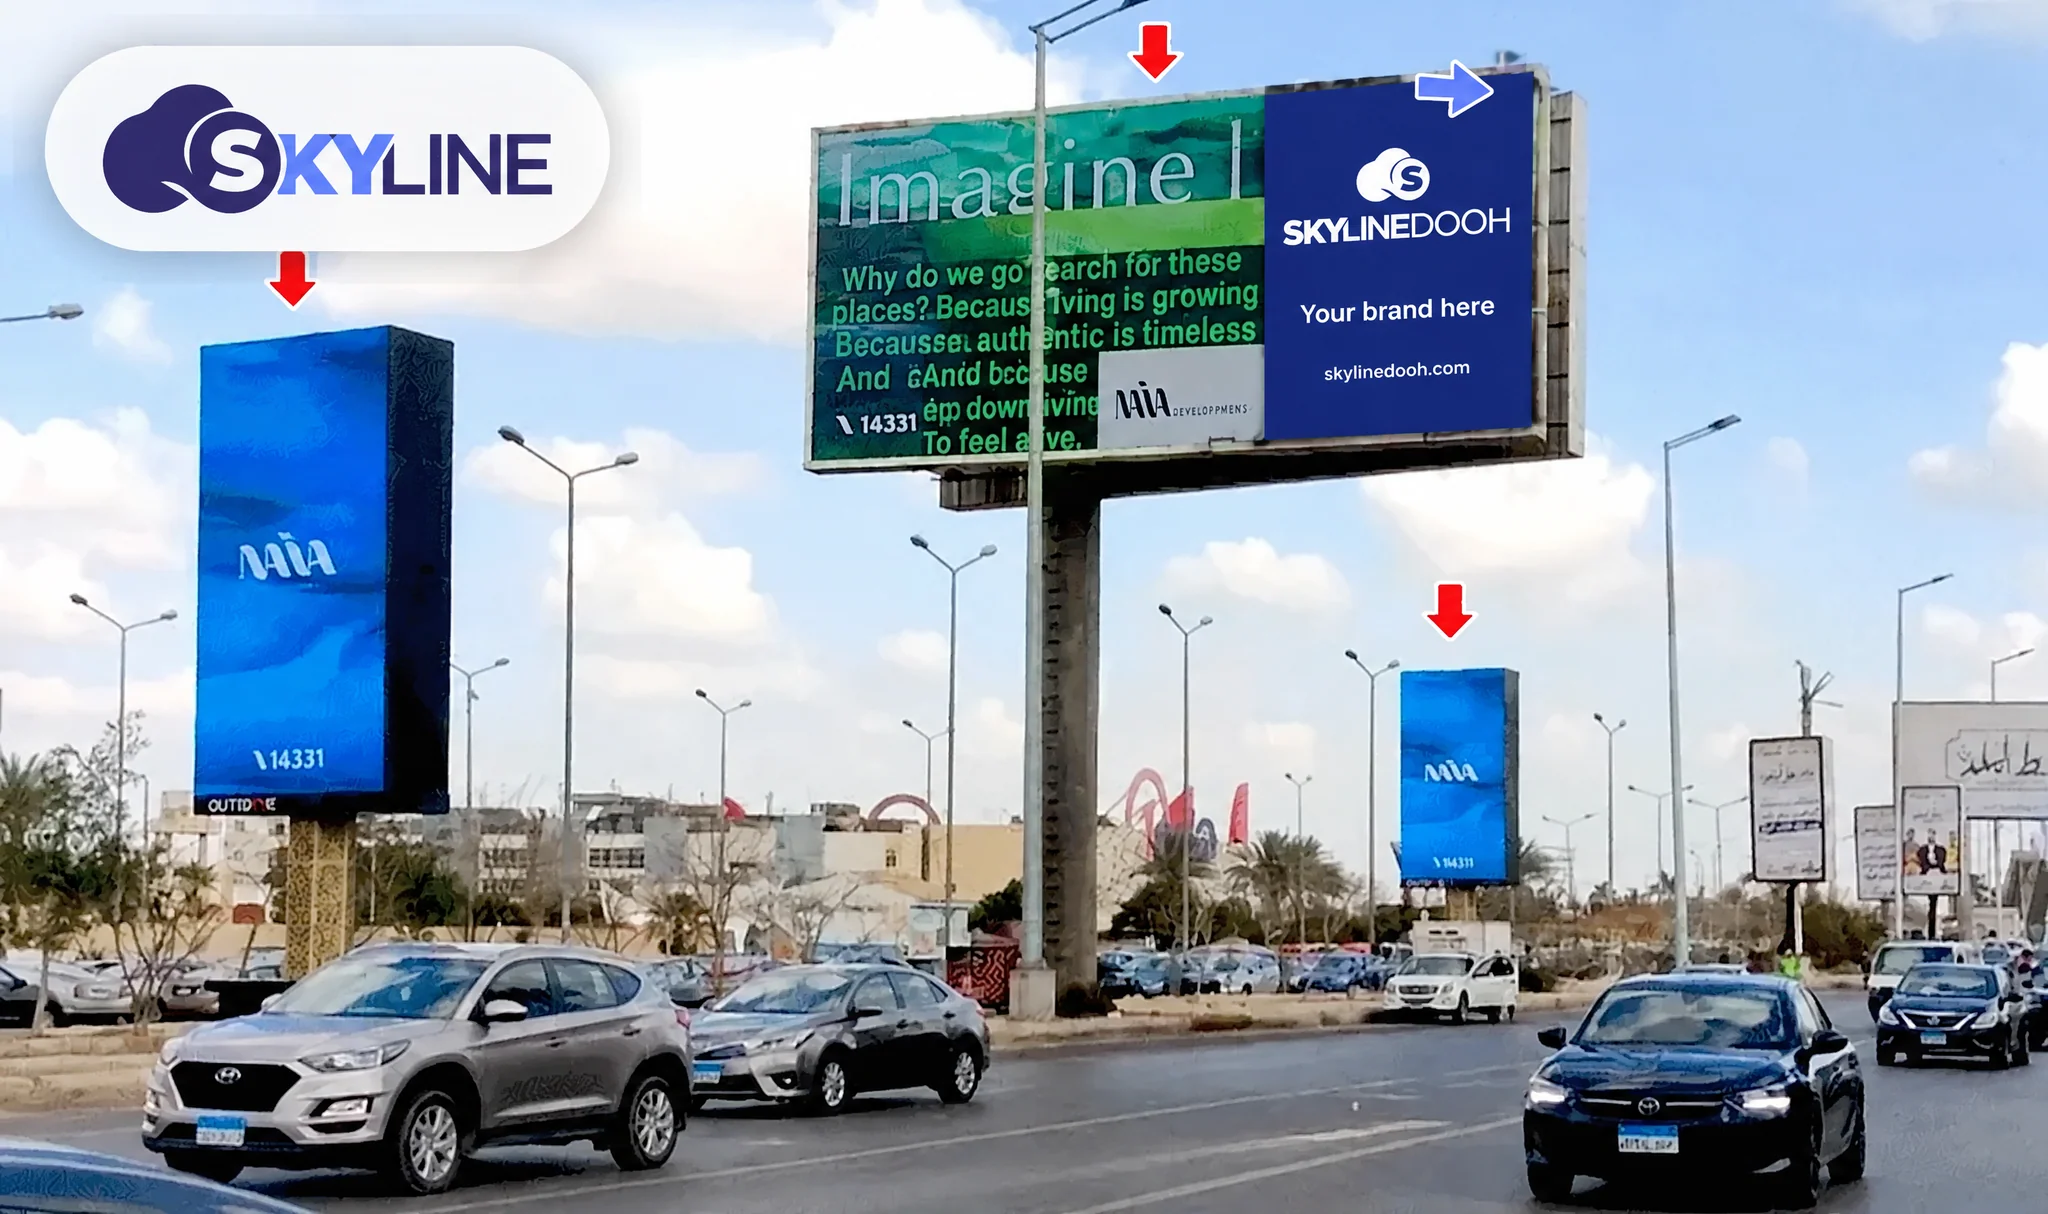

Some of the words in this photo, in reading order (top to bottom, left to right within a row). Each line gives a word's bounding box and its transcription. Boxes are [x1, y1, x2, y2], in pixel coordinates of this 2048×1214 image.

[838, 136, 1196, 227] Imagine
[1282, 207, 1511, 246] SKYLINEDOOH
[842, 264, 898, 296] Why
[905, 263, 938, 288] do
[946, 265, 984, 286] we
[991, 264, 1024, 290] go
[1043, 249, 1117, 281] earch
[1168, 249, 1242, 275] these
[832, 295, 930, 331] places?
[936, 294, 1032, 320] Becaus
[1123, 285, 1144, 312] is
[1152, 280, 1259, 316] growing
[1300, 303, 1356, 324] Your
[1362, 298, 1433, 322] brand
[1441, 297, 1496, 318] here
[1113, 320, 1135, 347] is
[1143, 315, 1256, 346] timeless
[835, 364, 890, 393] And
[1324, 361, 1471, 384] skylinedooh.com
[860, 412, 918, 435] 14331
[922, 430, 952, 455] To
[959, 427, 1008, 454] feel
[268, 748, 325, 771] 14331
